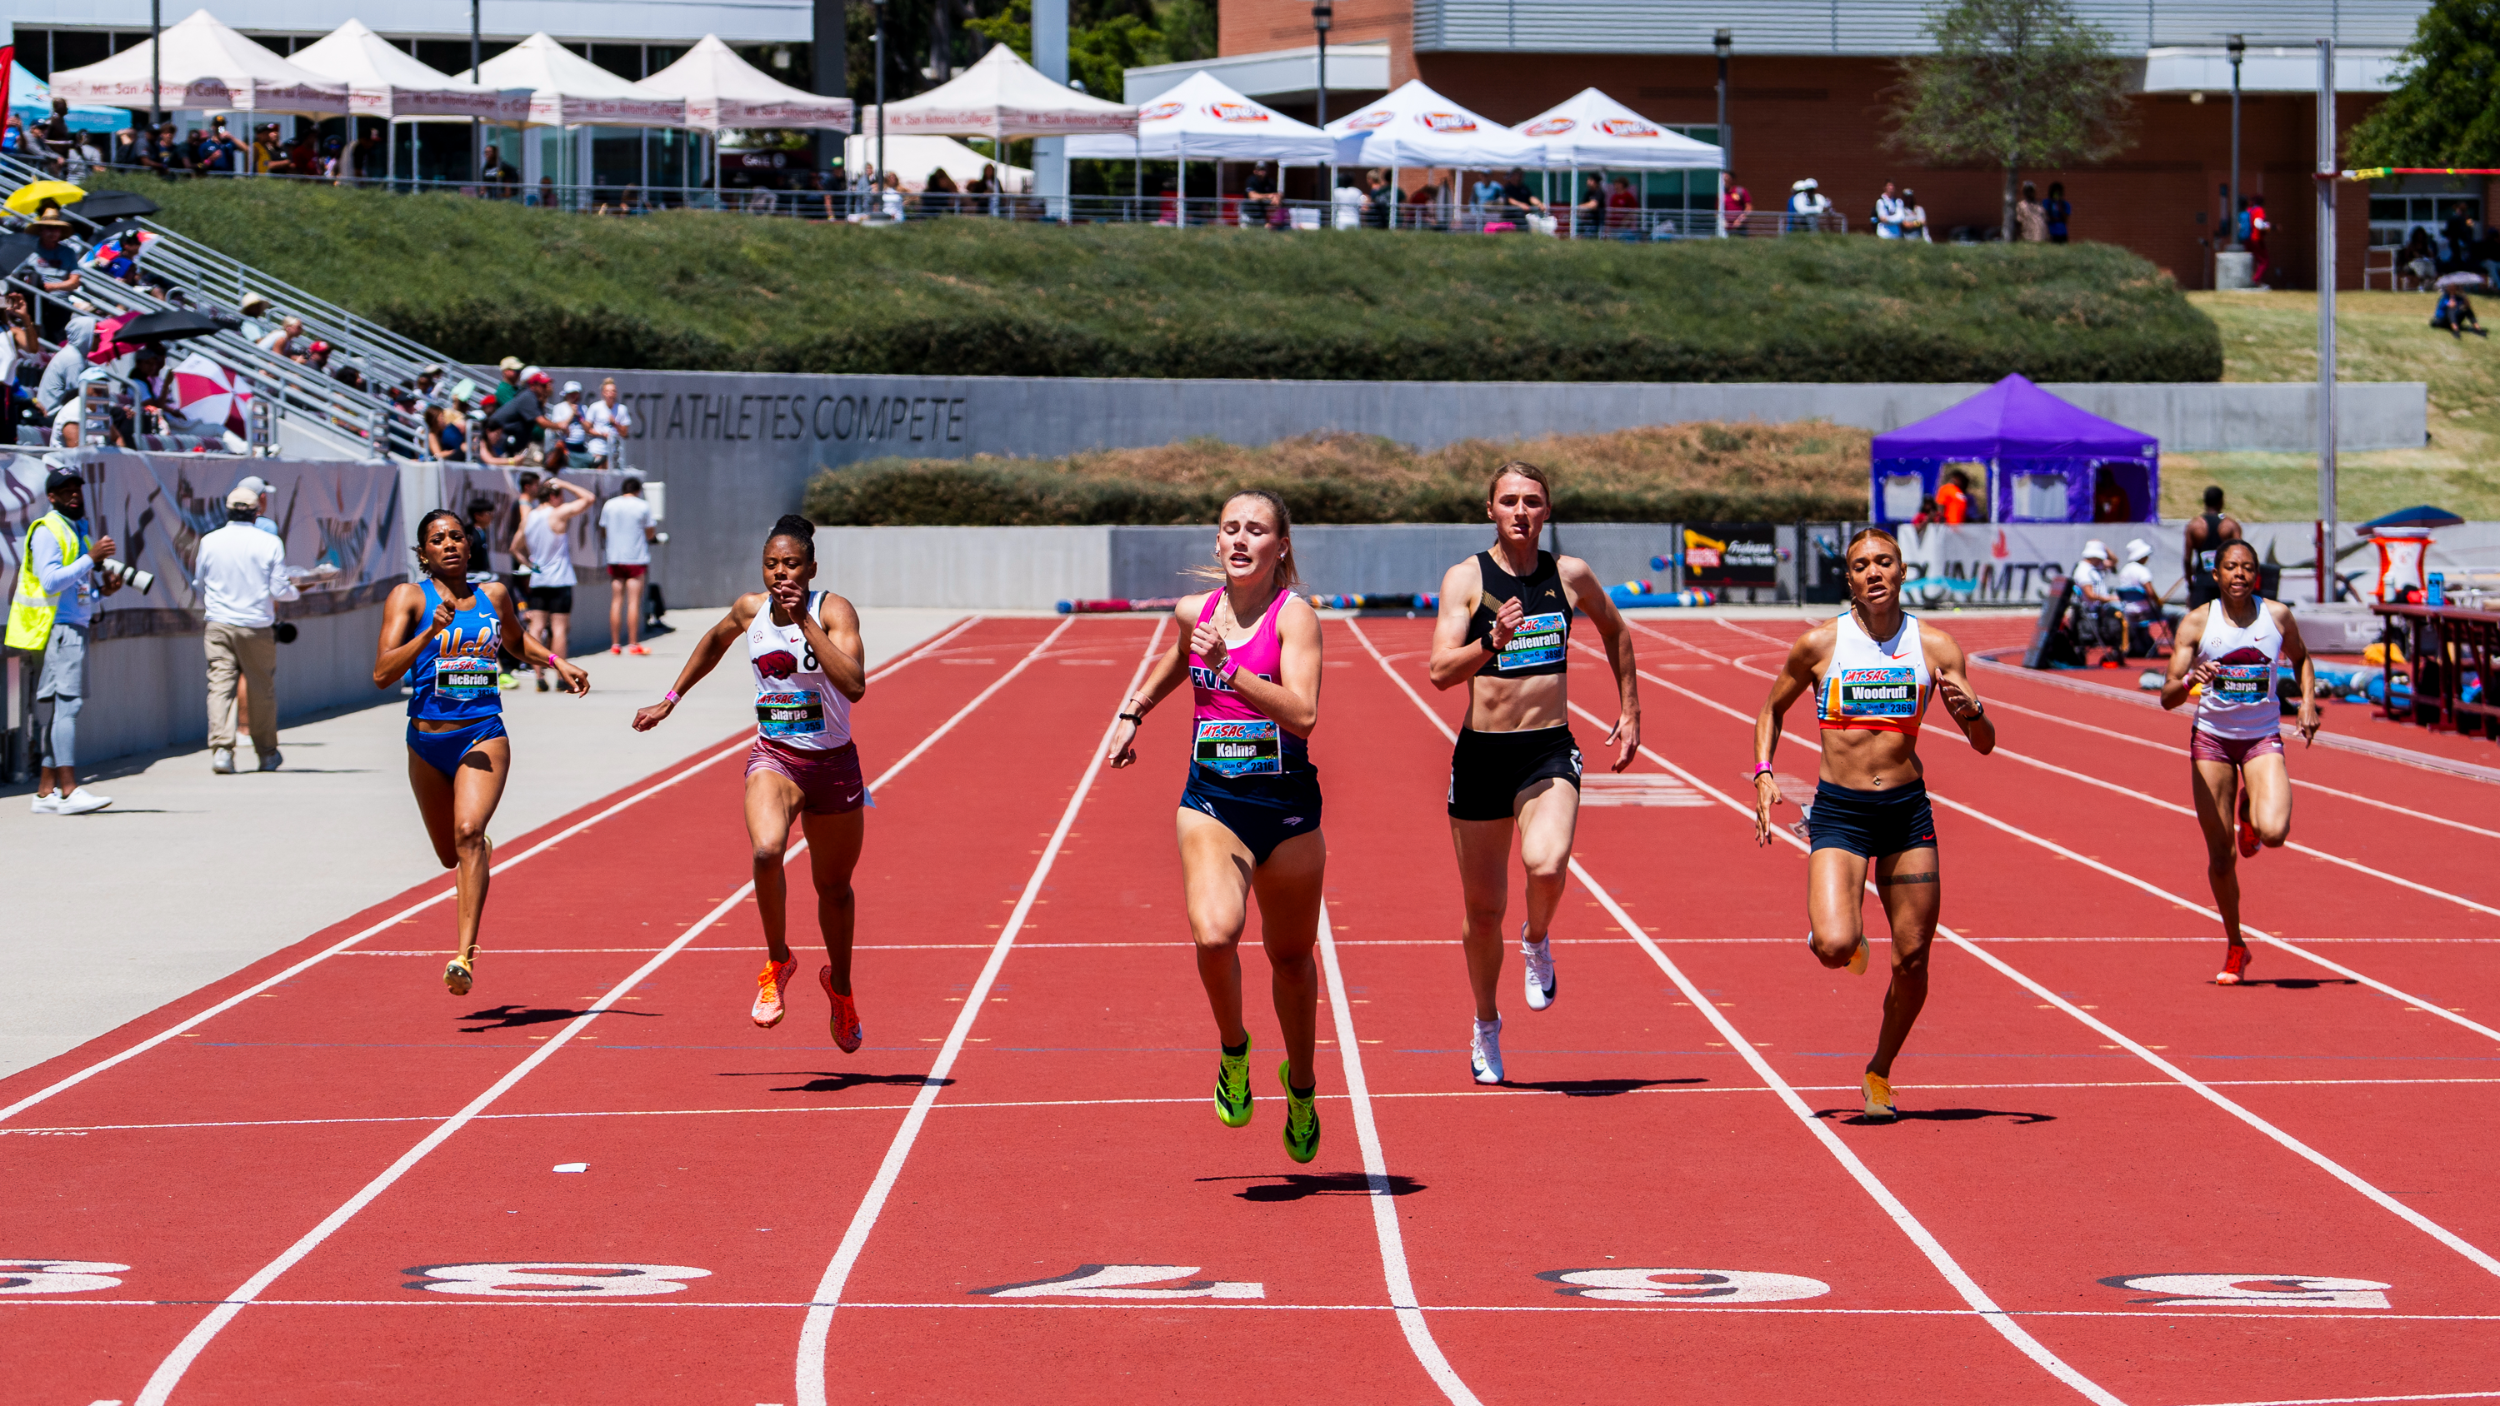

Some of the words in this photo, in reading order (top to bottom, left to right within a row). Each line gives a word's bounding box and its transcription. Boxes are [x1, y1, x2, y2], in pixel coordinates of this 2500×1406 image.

[114, 83, 137, 96] San
[665, 393, 805, 441] ATHLETES
[813, 396, 966, 443] COMPETE
[803, 641, 819, 672] 8
[448, 673, 489, 686] McBride
[2224, 679, 2258, 692] Sharpe
[1851, 685, 1908, 700] Woodruff
[770, 708, 808, 721] Sharpe
[1890, 703, 1912, 713] 2369
[804, 721, 822, 732] 255
[1216, 742, 1258, 758] Kalma
[1250, 760, 1274, 772] 2316
[403, 1261, 713, 1297] 8
